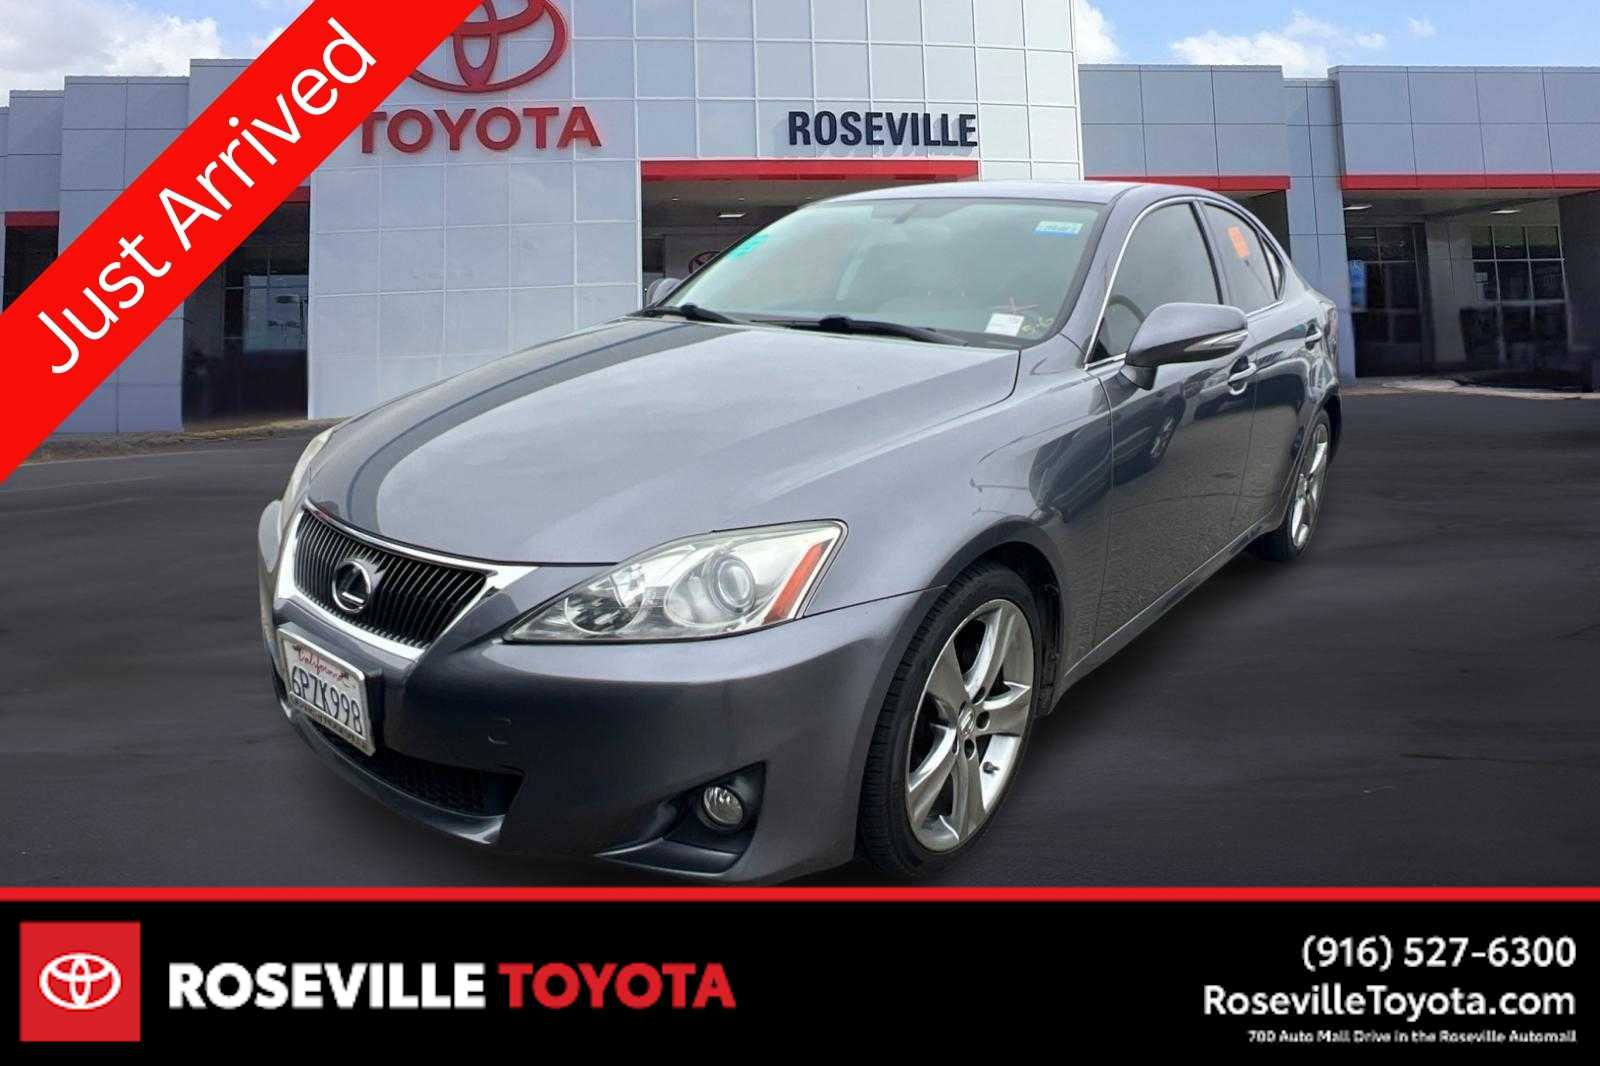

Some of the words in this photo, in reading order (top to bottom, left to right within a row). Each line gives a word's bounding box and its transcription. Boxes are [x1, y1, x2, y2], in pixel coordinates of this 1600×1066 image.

[361, 106, 602, 154] TOYOTA
[788, 110, 978, 148] ROSEVILLE
[291, 665, 363, 736] 6PZK998
